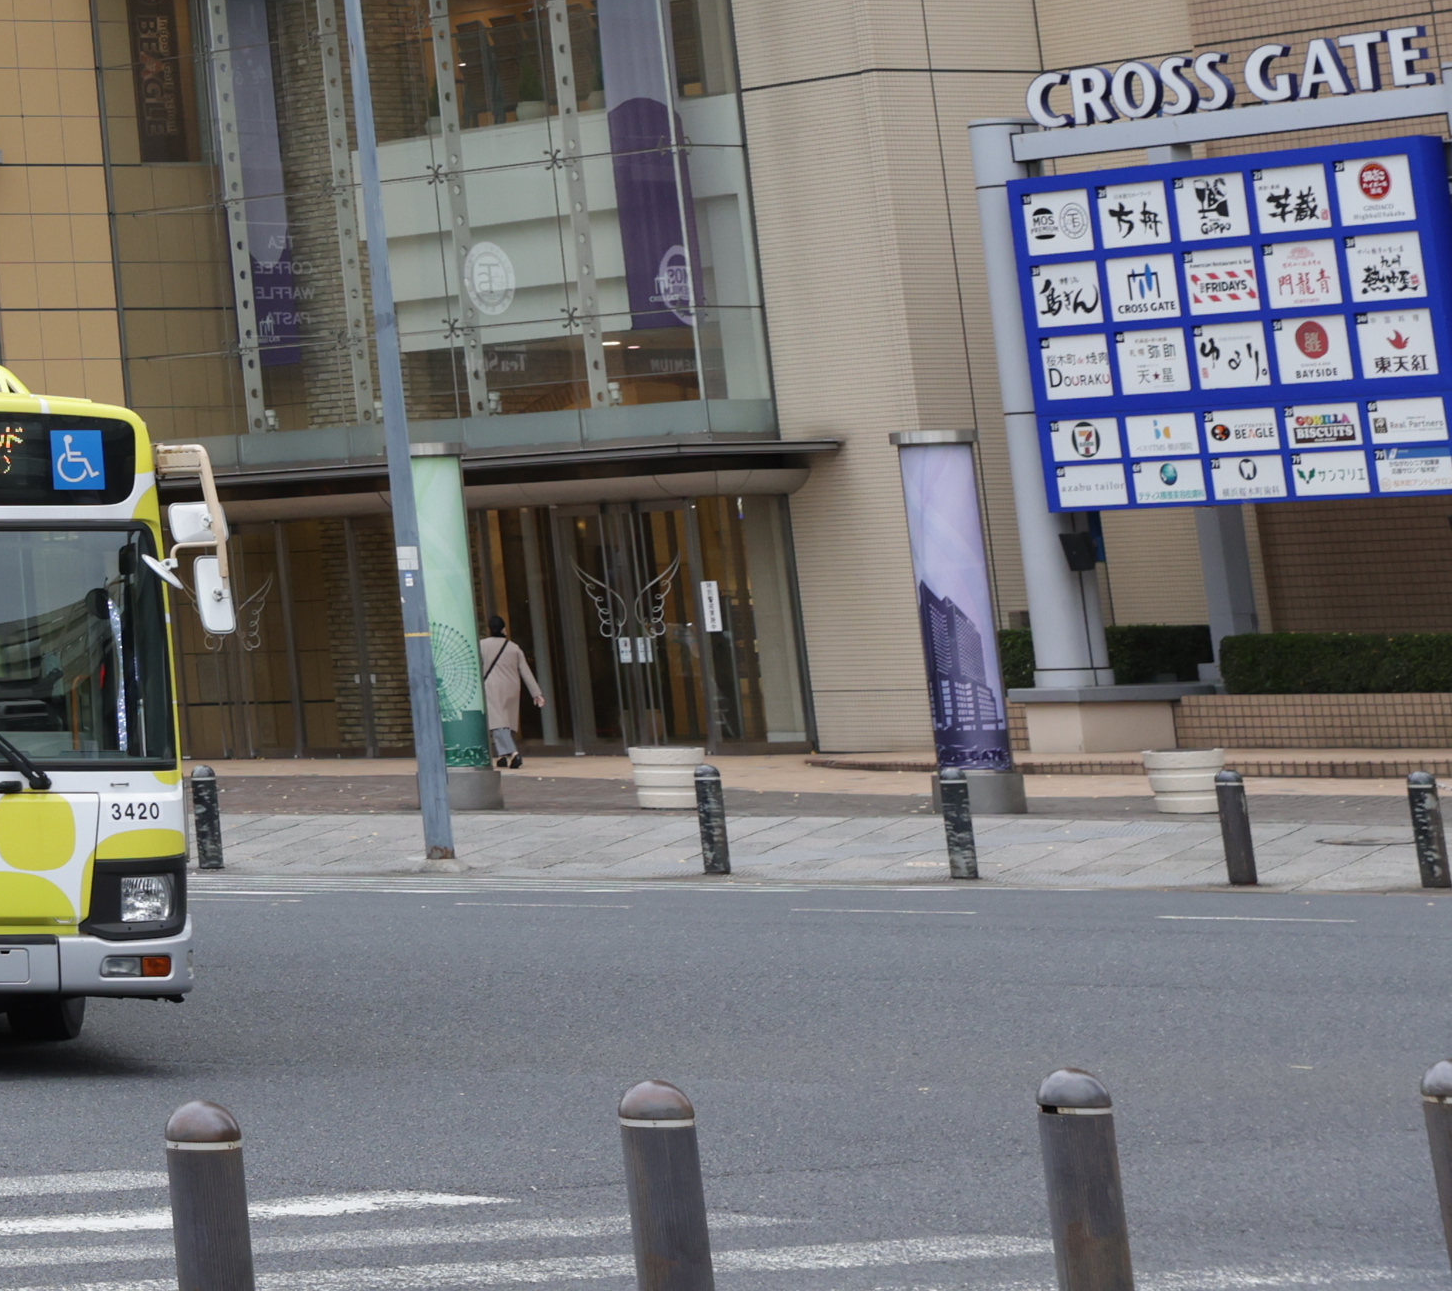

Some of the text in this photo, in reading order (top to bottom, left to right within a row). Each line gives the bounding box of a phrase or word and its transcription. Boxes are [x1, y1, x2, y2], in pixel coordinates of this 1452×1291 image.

[1026, 26, 1430, 128] CROSS GATE
[1032, 215, 1055, 226] MOS
[1205, 280, 1247, 293] FRIDAYS
[1118, 301, 1176, 314] CROSS GATE
[1304, 332, 1319, 342] BAY
[1304, 341, 1323, 352] SIDE
[1374, 354, 1430, 373] 東天紅
[1048, 368, 1111, 389] DOURAKU
[1296, 368, 1339, 379] BAYSIDE
[1234, 427, 1275, 439] BEAGLE
[1296, 426, 1354, 440] BISCUITS
[1318, 468, 1366, 482] サンマリエ
[1061, 481, 1125, 492] azabu tailor
[111, 802, 160, 821] 3420
